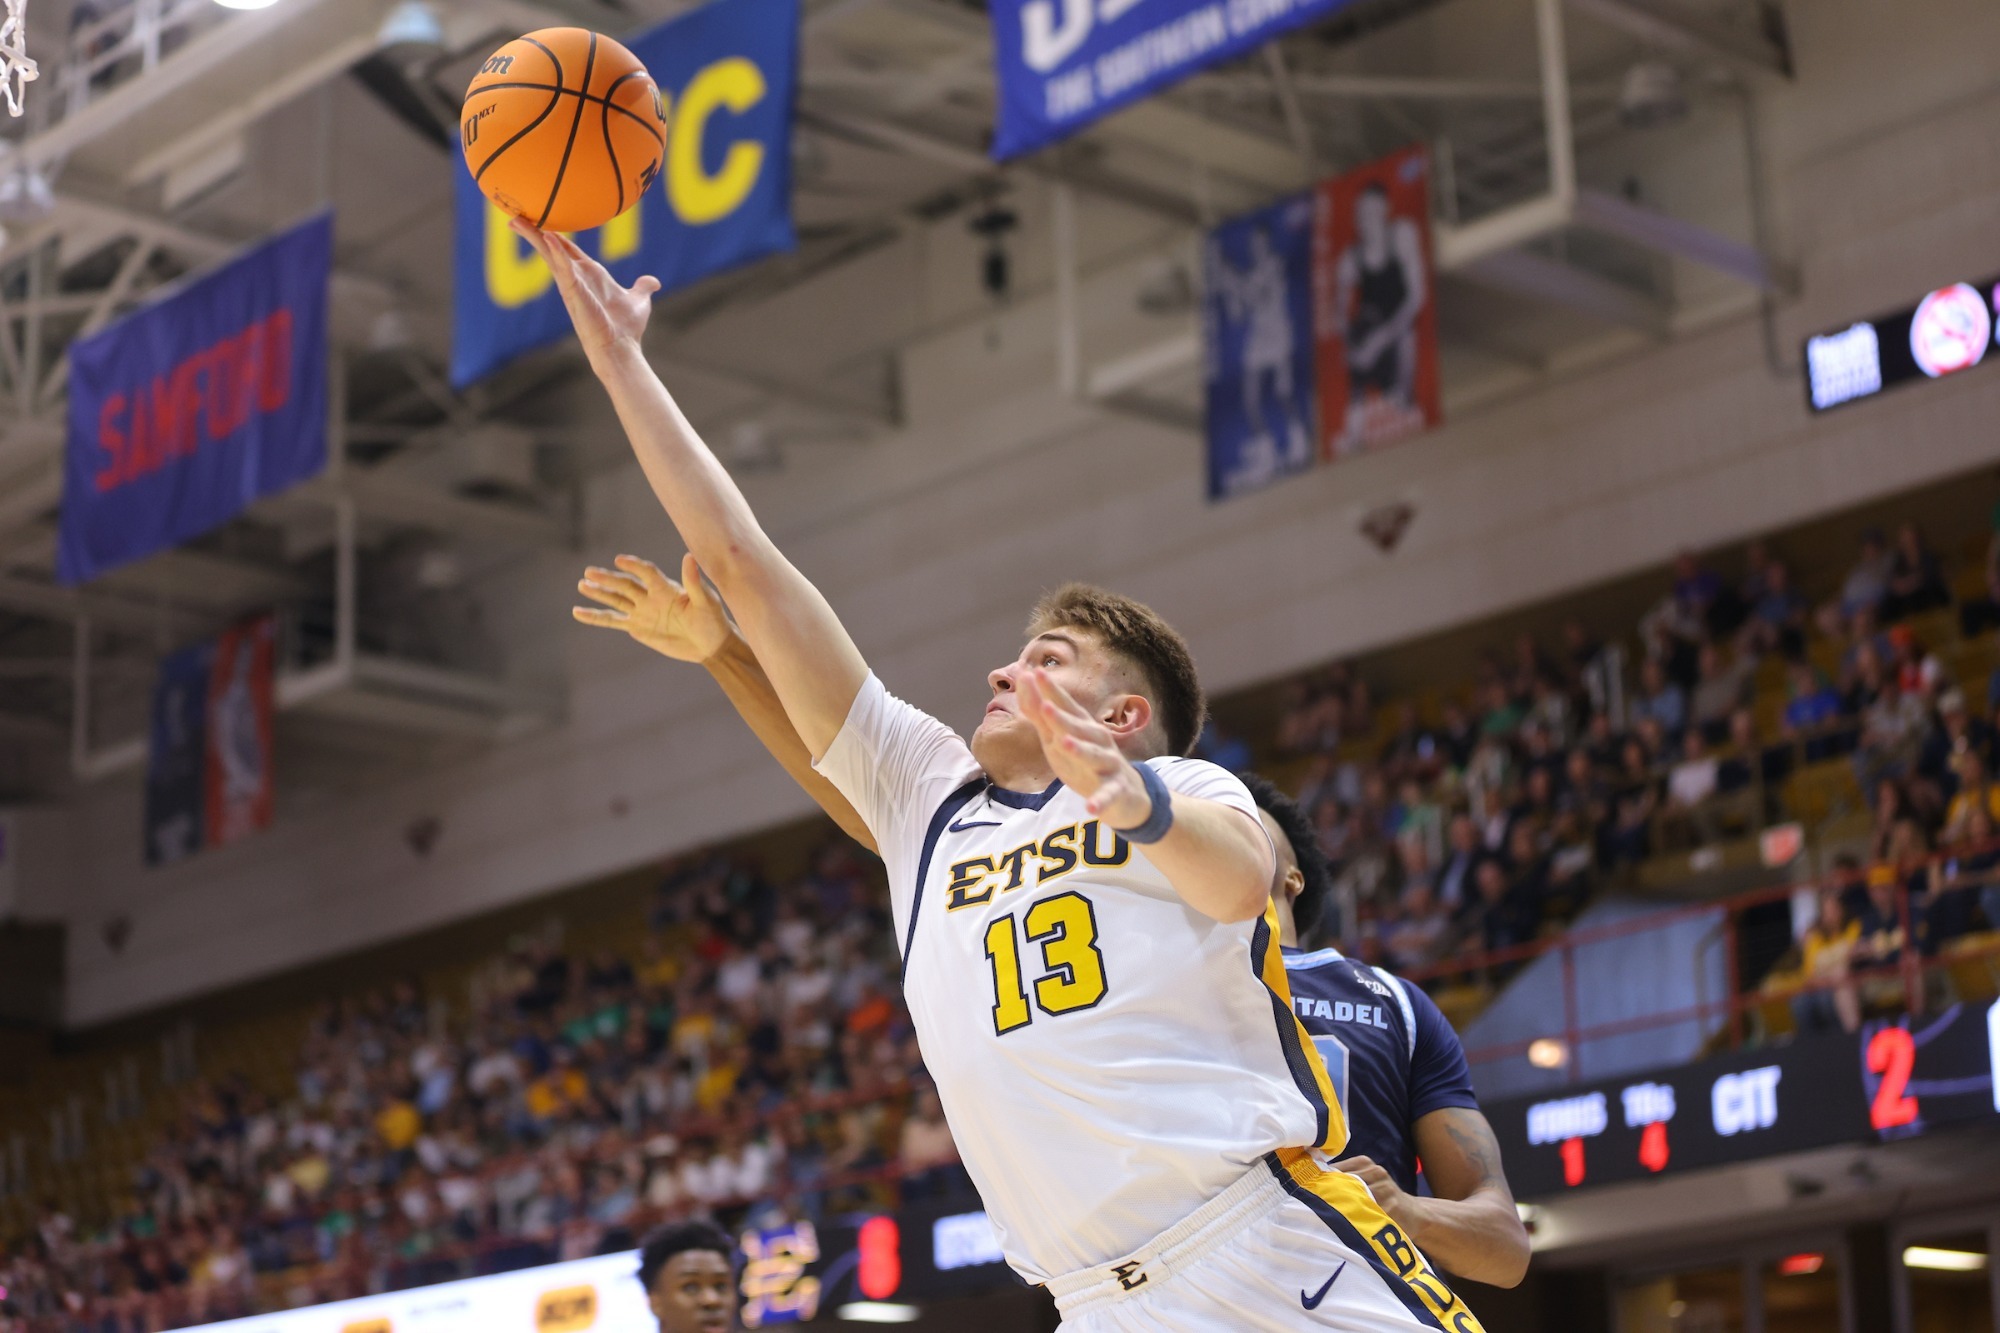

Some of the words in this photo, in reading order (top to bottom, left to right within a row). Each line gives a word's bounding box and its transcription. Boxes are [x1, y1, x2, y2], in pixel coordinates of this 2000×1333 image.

[479, 103, 497, 120] NXT
[95, 309, 293, 492] SAMFORD
[946, 818, 1132, 912] ETSU
[984, 890, 1109, 1037] 13
[1711, 1065, 1782, 1137] CIT
[1866, 1027, 1919, 1130] 2
[1559, 1136, 1586, 1187] 1
